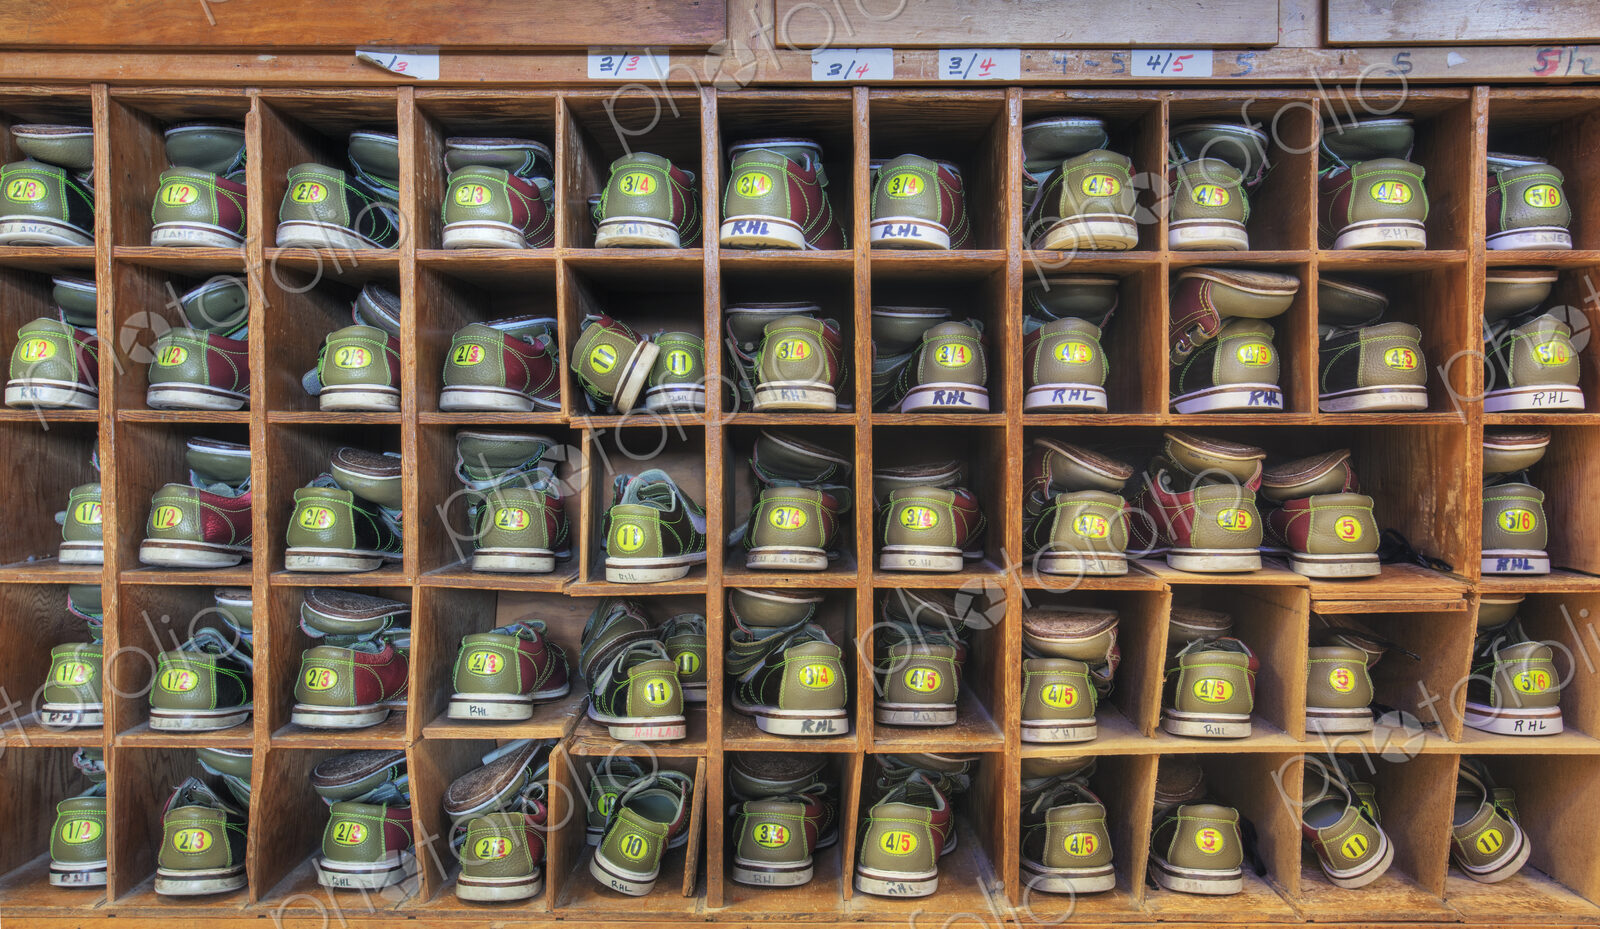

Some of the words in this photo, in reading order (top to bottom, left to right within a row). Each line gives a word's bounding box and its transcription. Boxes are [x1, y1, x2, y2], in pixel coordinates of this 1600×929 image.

[600, 52, 640, 76] 2/3
[827, 60, 869, 79] 3/4
[949, 53, 995, 79] 3/4
[1146, 53, 1192, 73] 4/5
[11, 182, 37, 198] 2/3
[298, 184, 320, 200] 2/3
[625, 176, 649, 193] 3/4
[741, 176, 765, 193] 3/4
[892, 178, 917, 195] 3/4
[1088, 176, 1114, 194] 4/5
[1377, 183, 1407, 202] 4/5
[167, 186, 189, 203] 1/2
[461, 186, 484, 203] 2/3
[1199, 187, 1224, 205] 4/5
[1530, 189, 1556, 206] 5/6
[731, 221, 770, 236] RHL
[881, 225, 922, 238] RHL
[26, 341, 47, 360] 1/2
[160, 348, 180, 365] 1/2
[341, 349, 365, 366] 2/3
[458, 345, 480, 363] 2/3
[593, 348, 615, 369] 11
[780, 343, 805, 360] 3/4
[940, 346, 965, 364] 3/4
[1061, 342, 1087, 362] 4/5
[1245, 346, 1267, 364] 4/5
[1391, 349, 1413, 368] 4/5
[1540, 344, 1565, 362] 5/6
[672, 354, 687, 371] 11
[933, 390, 972, 406] RHL
[1052, 389, 1095, 403] RHL
[1532, 392, 1570, 407] RHL
[156, 510, 176, 527] 1/2
[304, 510, 328, 527] 2/3
[499, 510, 524, 527] 2/3
[775, 510, 800, 528] 3/4
[907, 509, 932, 527] 3/4
[1078, 518, 1105, 536] 4/5
[1222, 511, 1247, 529] 4/5
[1504, 512, 1530, 529] 5/6
[622, 527, 639, 547] 11
[1342, 520, 1355, 540] 5
[471, 654, 496, 671] 2/3
[678, 655, 693, 672] 11
[62, 664, 85, 682] 1/2
[167, 671, 189, 690] 1/2
[309, 669, 330, 686] 2/3
[804, 666, 829, 684] 3/4
[910, 670, 935, 689] 4/5
[1337, 671, 1348, 690] 5
[647, 683, 664, 701] 11
[1200, 681, 1225, 699] 4/5
[1522, 675, 1546, 691] 5/6
[1048, 686, 1073, 704] 4/5
[469, 705, 489, 717] RHL
[801, 719, 837, 735] RHL
[1514, 719, 1546, 732] RHL
[67, 823, 90, 841] 1/2
[180, 831, 205, 850] 2/3
[338, 824, 361, 842] 2/3
[759, 825, 785, 844] 3/4
[1202, 831, 1216, 851] 5
[481, 840, 506, 858] 2/3
[625, 836, 643, 857] 10
[885, 833, 911, 852] 4/5
[1069, 835, 1093, 854] 4/5
[1345, 837, 1365, 858] 11
[1480, 831, 1501, 852] 11
[611, 880, 633, 893] RHL
